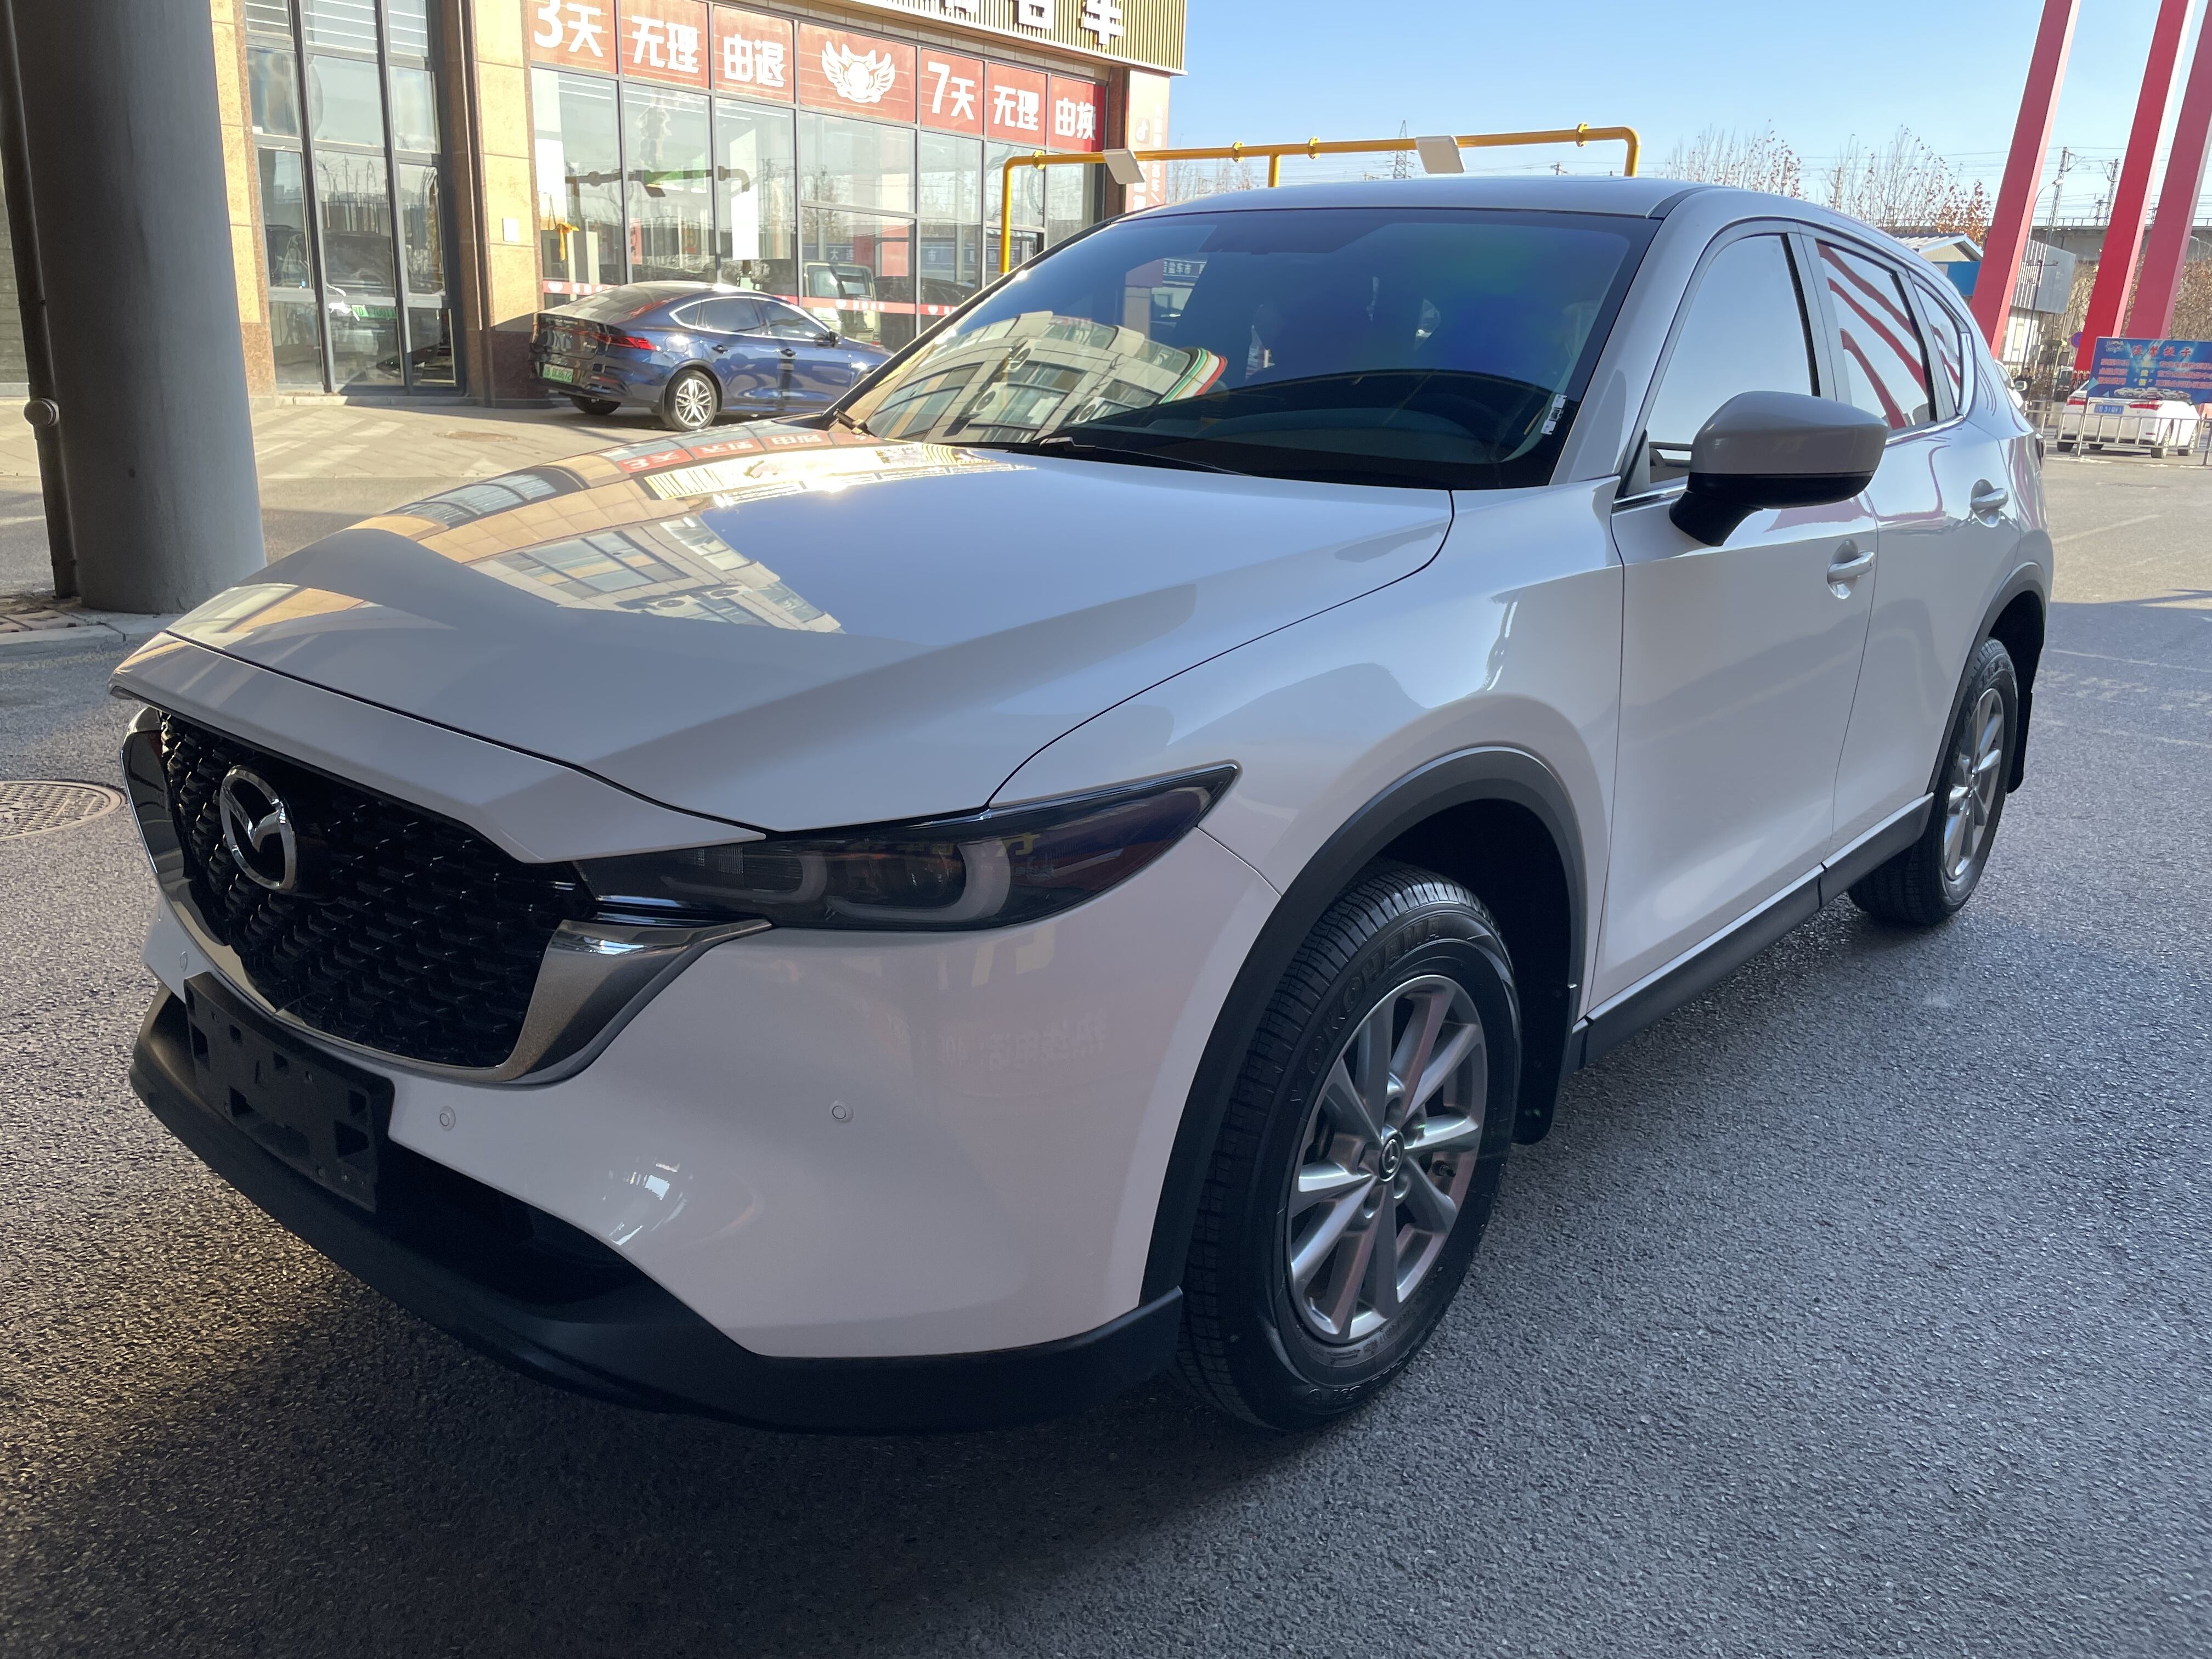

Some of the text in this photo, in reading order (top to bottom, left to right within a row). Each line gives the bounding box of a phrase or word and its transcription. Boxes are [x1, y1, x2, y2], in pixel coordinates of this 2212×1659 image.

[534, 0, 785, 87] 3天 无理 由退
[927, 61, 975, 121] 7天
[993, 84, 1040, 131] 无理
